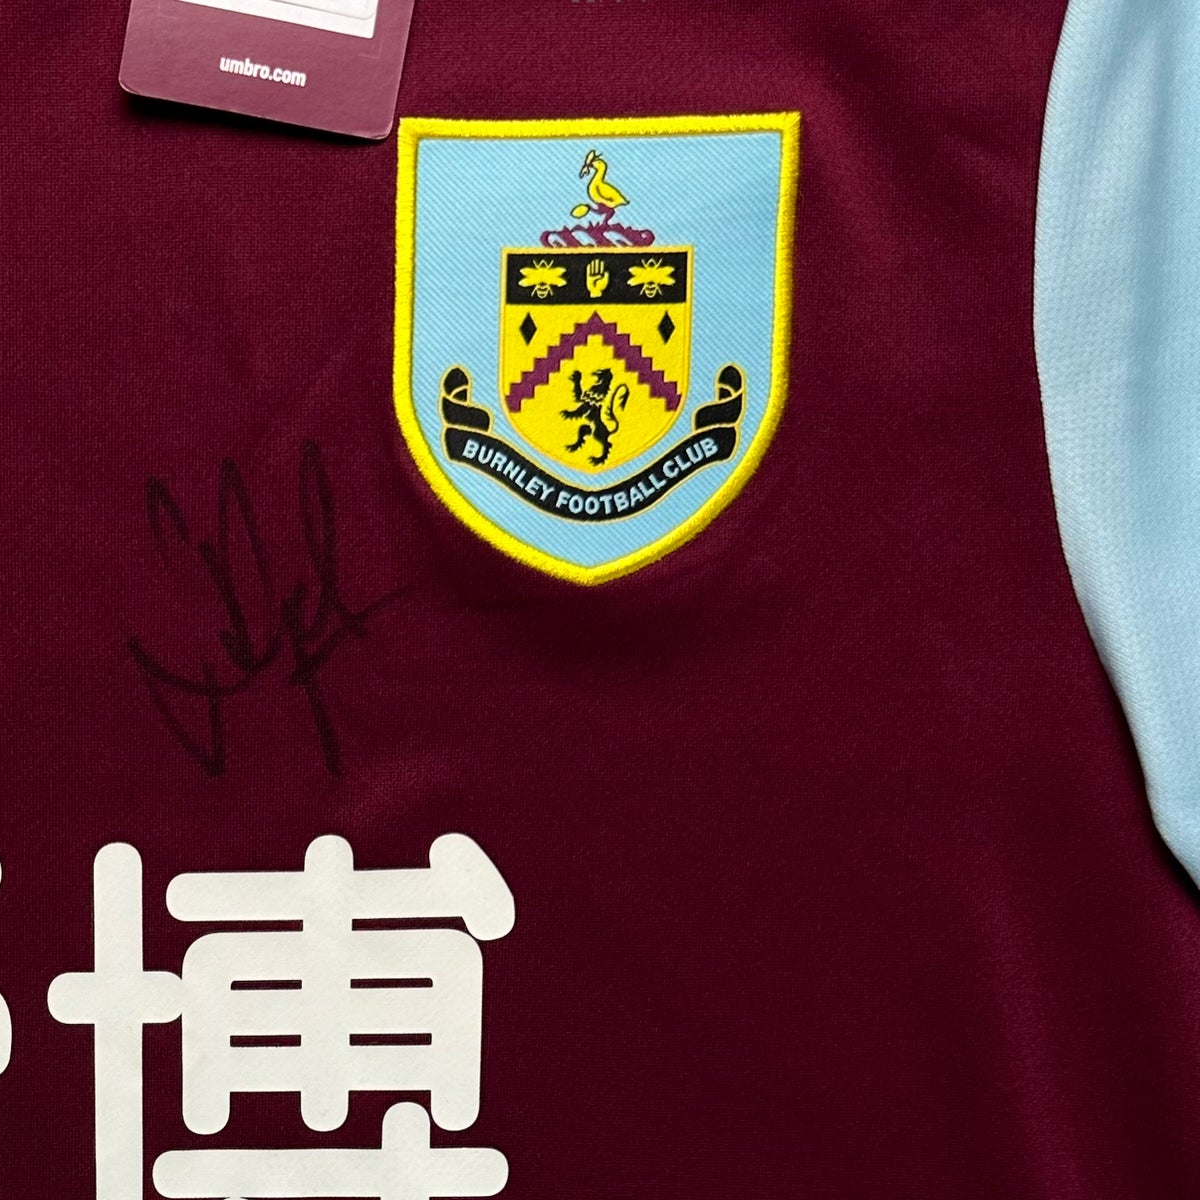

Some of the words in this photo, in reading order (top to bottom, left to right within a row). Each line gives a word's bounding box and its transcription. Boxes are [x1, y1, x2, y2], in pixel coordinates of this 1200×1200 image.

[219, 57, 307, 87] umbro.com
[461, 438, 555, 502] BURNLEY
[555, 473, 667, 515] FOOTBALL
[662, 436, 719, 479] CLUB
